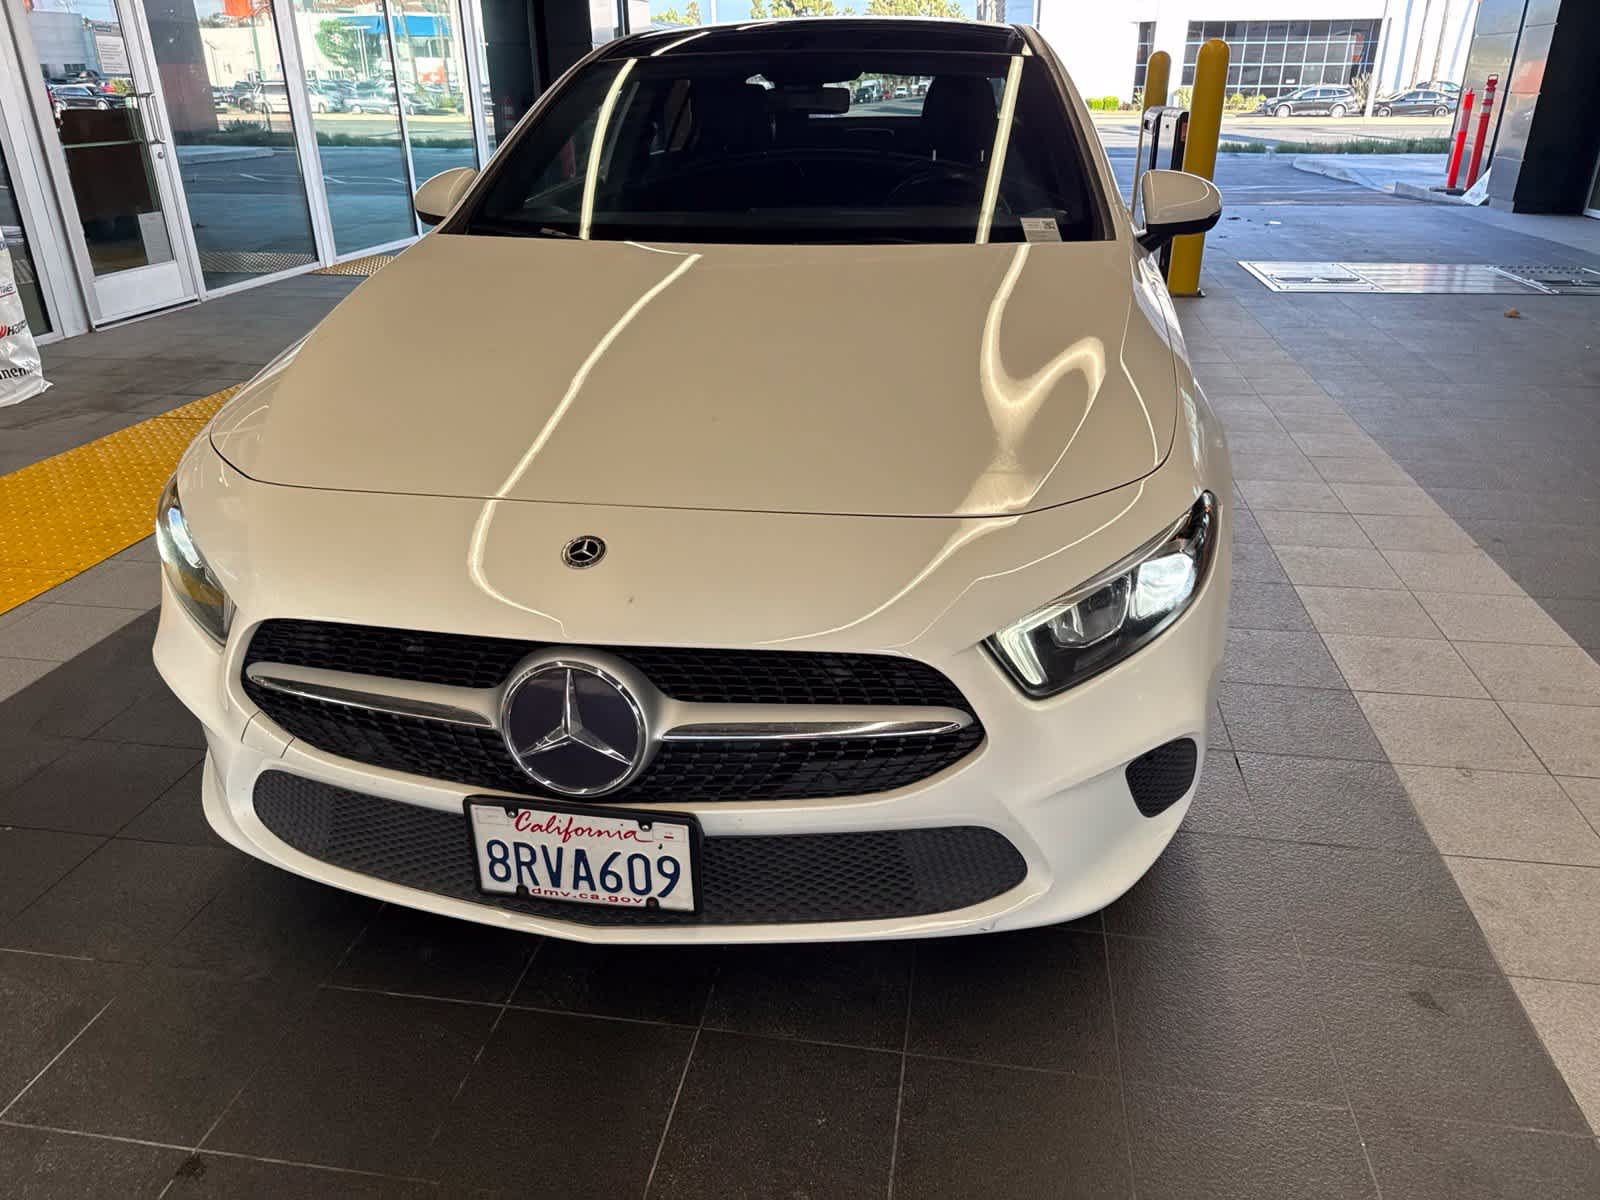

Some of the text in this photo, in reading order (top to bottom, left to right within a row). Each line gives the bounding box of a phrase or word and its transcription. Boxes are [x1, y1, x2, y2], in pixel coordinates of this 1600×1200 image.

[513, 810, 654, 844] California
[486, 838, 681, 898] 8RVA609
[530, 886, 643, 905] dmv.ca.gov
